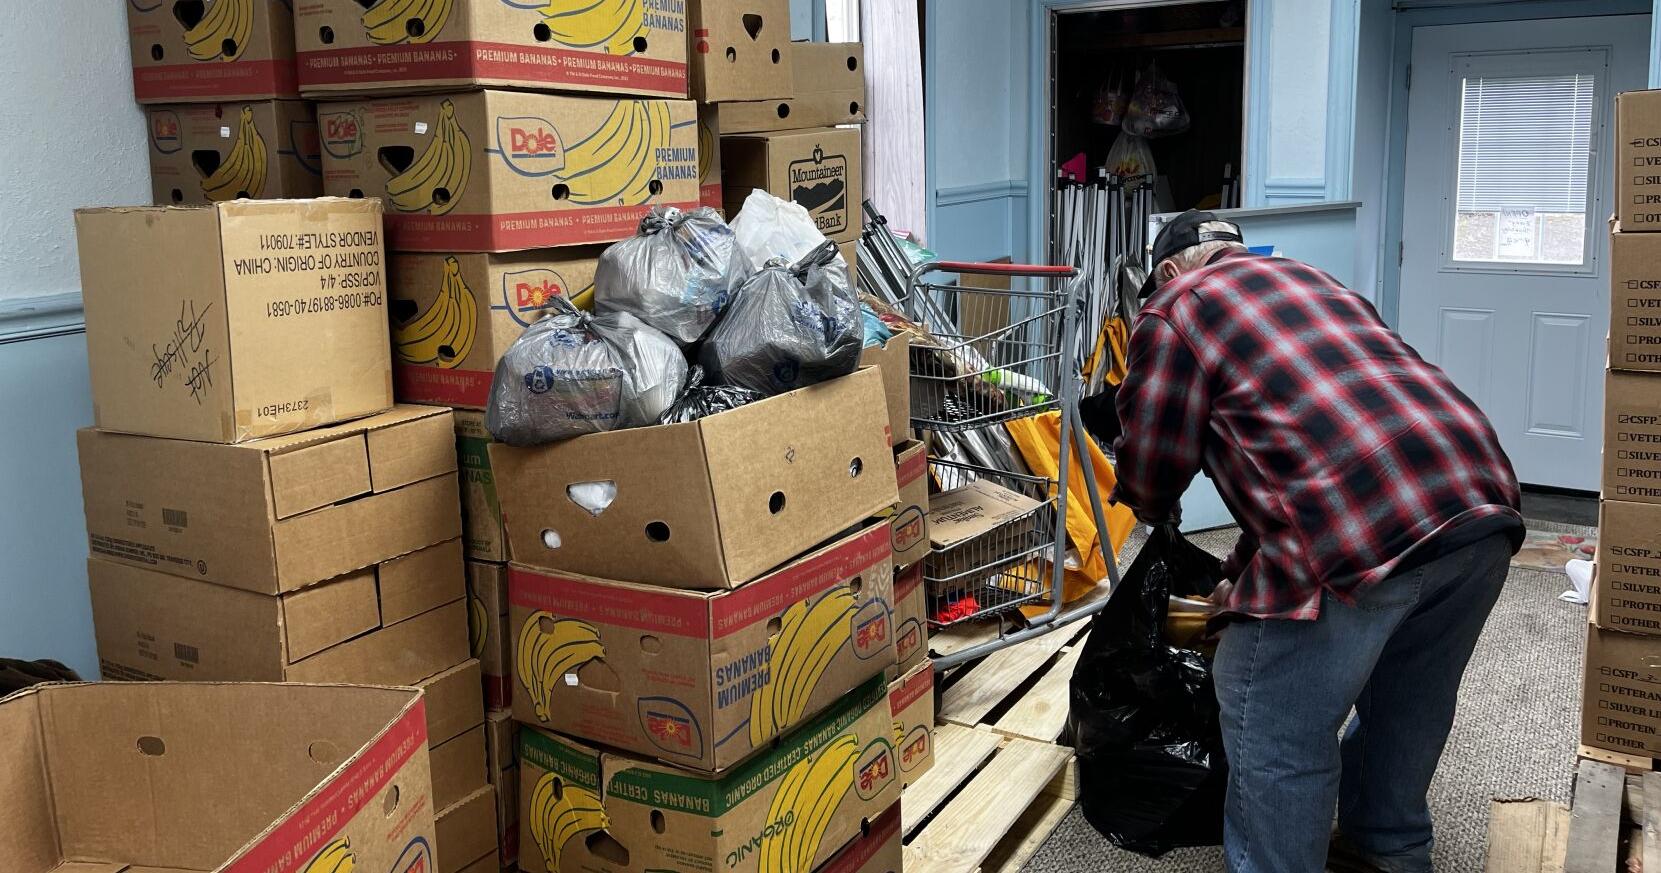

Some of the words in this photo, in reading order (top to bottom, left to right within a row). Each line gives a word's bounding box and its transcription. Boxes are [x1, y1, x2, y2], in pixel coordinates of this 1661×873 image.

[642, 0, 685, 14] PREMIUM
[643, 13, 685, 33] BANANAS
[377, 51, 412, 65] PREMIUM
[412, 49, 454, 62] BANANAS
[476, 49, 518, 63] PREMIUM
[519, 52, 558, 66] BANANAS
[563, 56, 597, 70] PREMIUM
[597, 60, 629, 73] BANANAS
[632, 63, 660, 76] PREMIUM
[660, 67, 686, 79] BANANAS
[511, 127, 556, 154] Dole
[655, 147, 696, 162] PREMIUM
[656, 165, 697, 180] BANANAS
[792, 165, 844, 183] Mountaineer
[500, 219, 538, 231] PREMIUM
[538, 217, 573, 229] BANANAS
[582, 214, 613, 225] PREMIUM
[613, 211, 642, 222] BANANAS
[338, 231, 379, 248] VENDOR
[234, 257, 272, 276] CHINA
[274, 254, 316, 273] ORIGIN:
[318, 253, 332, 269] OF
[334, 251, 379, 269] COUNTRY
[516, 280, 561, 307] Dole
[257, 400, 309, 417] 2373HE01
[1629, 416, 1657, 425] CSFP
[1628, 486, 1661, 496] OTHE
[896, 518, 920, 545] Dole
[1624, 547, 1651, 558] CSFP
[1622, 582, 1661, 594] SILVER
[753, 592, 784, 611] PREMIUM
[718, 610, 752, 627] BANANAS
[1621, 617, 1660, 629] OTHER
[856, 618, 886, 650] Dole
[716, 644, 771, 687] BANANAS
[1612, 668, 1638, 680] CSFP
[718, 666, 771, 710] PREMIUM
[1609, 702, 1647, 717] SILVER
[836, 707, 862, 733] ORGANIC
[1608, 718, 1656, 735] PROTEIN
[804, 724, 836, 754] BANANAS
[1607, 735, 1646, 750] OTHER
[384, 735, 415, 771] PREMIUM
[903, 735, 926, 763] Dole
[764, 747, 801, 781] CERTIFIED
[860, 755, 889, 791] Dole
[347, 767, 384, 808] BANANAS
[726, 775, 763, 807] ORGANIC
[653, 789, 710, 813] BANANAS
[294, 810, 338, 859] PREMIUM
[726, 810, 795, 868] ORGANIC
